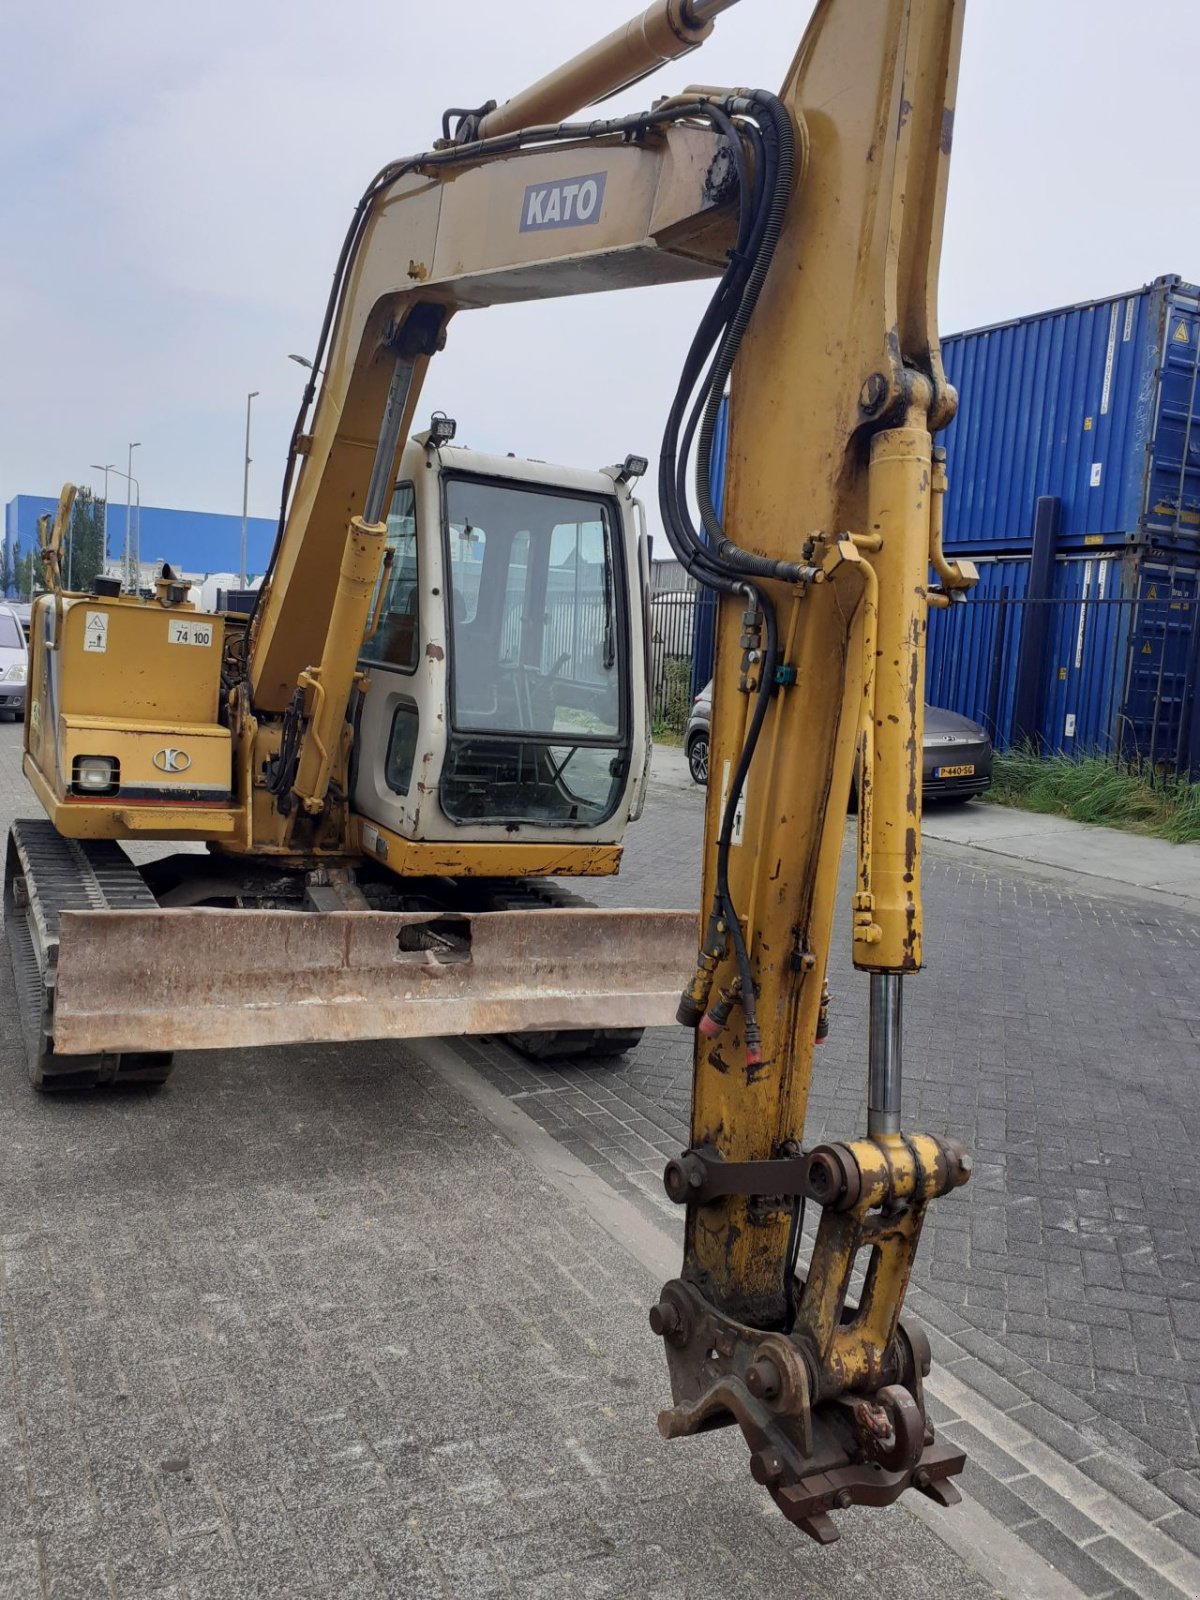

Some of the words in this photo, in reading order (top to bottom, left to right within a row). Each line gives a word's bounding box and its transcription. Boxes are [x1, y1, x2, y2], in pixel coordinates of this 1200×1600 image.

[527, 180, 597, 224] KATO
[176, 630, 188, 642] 74
[194, 632, 209, 644] 100
